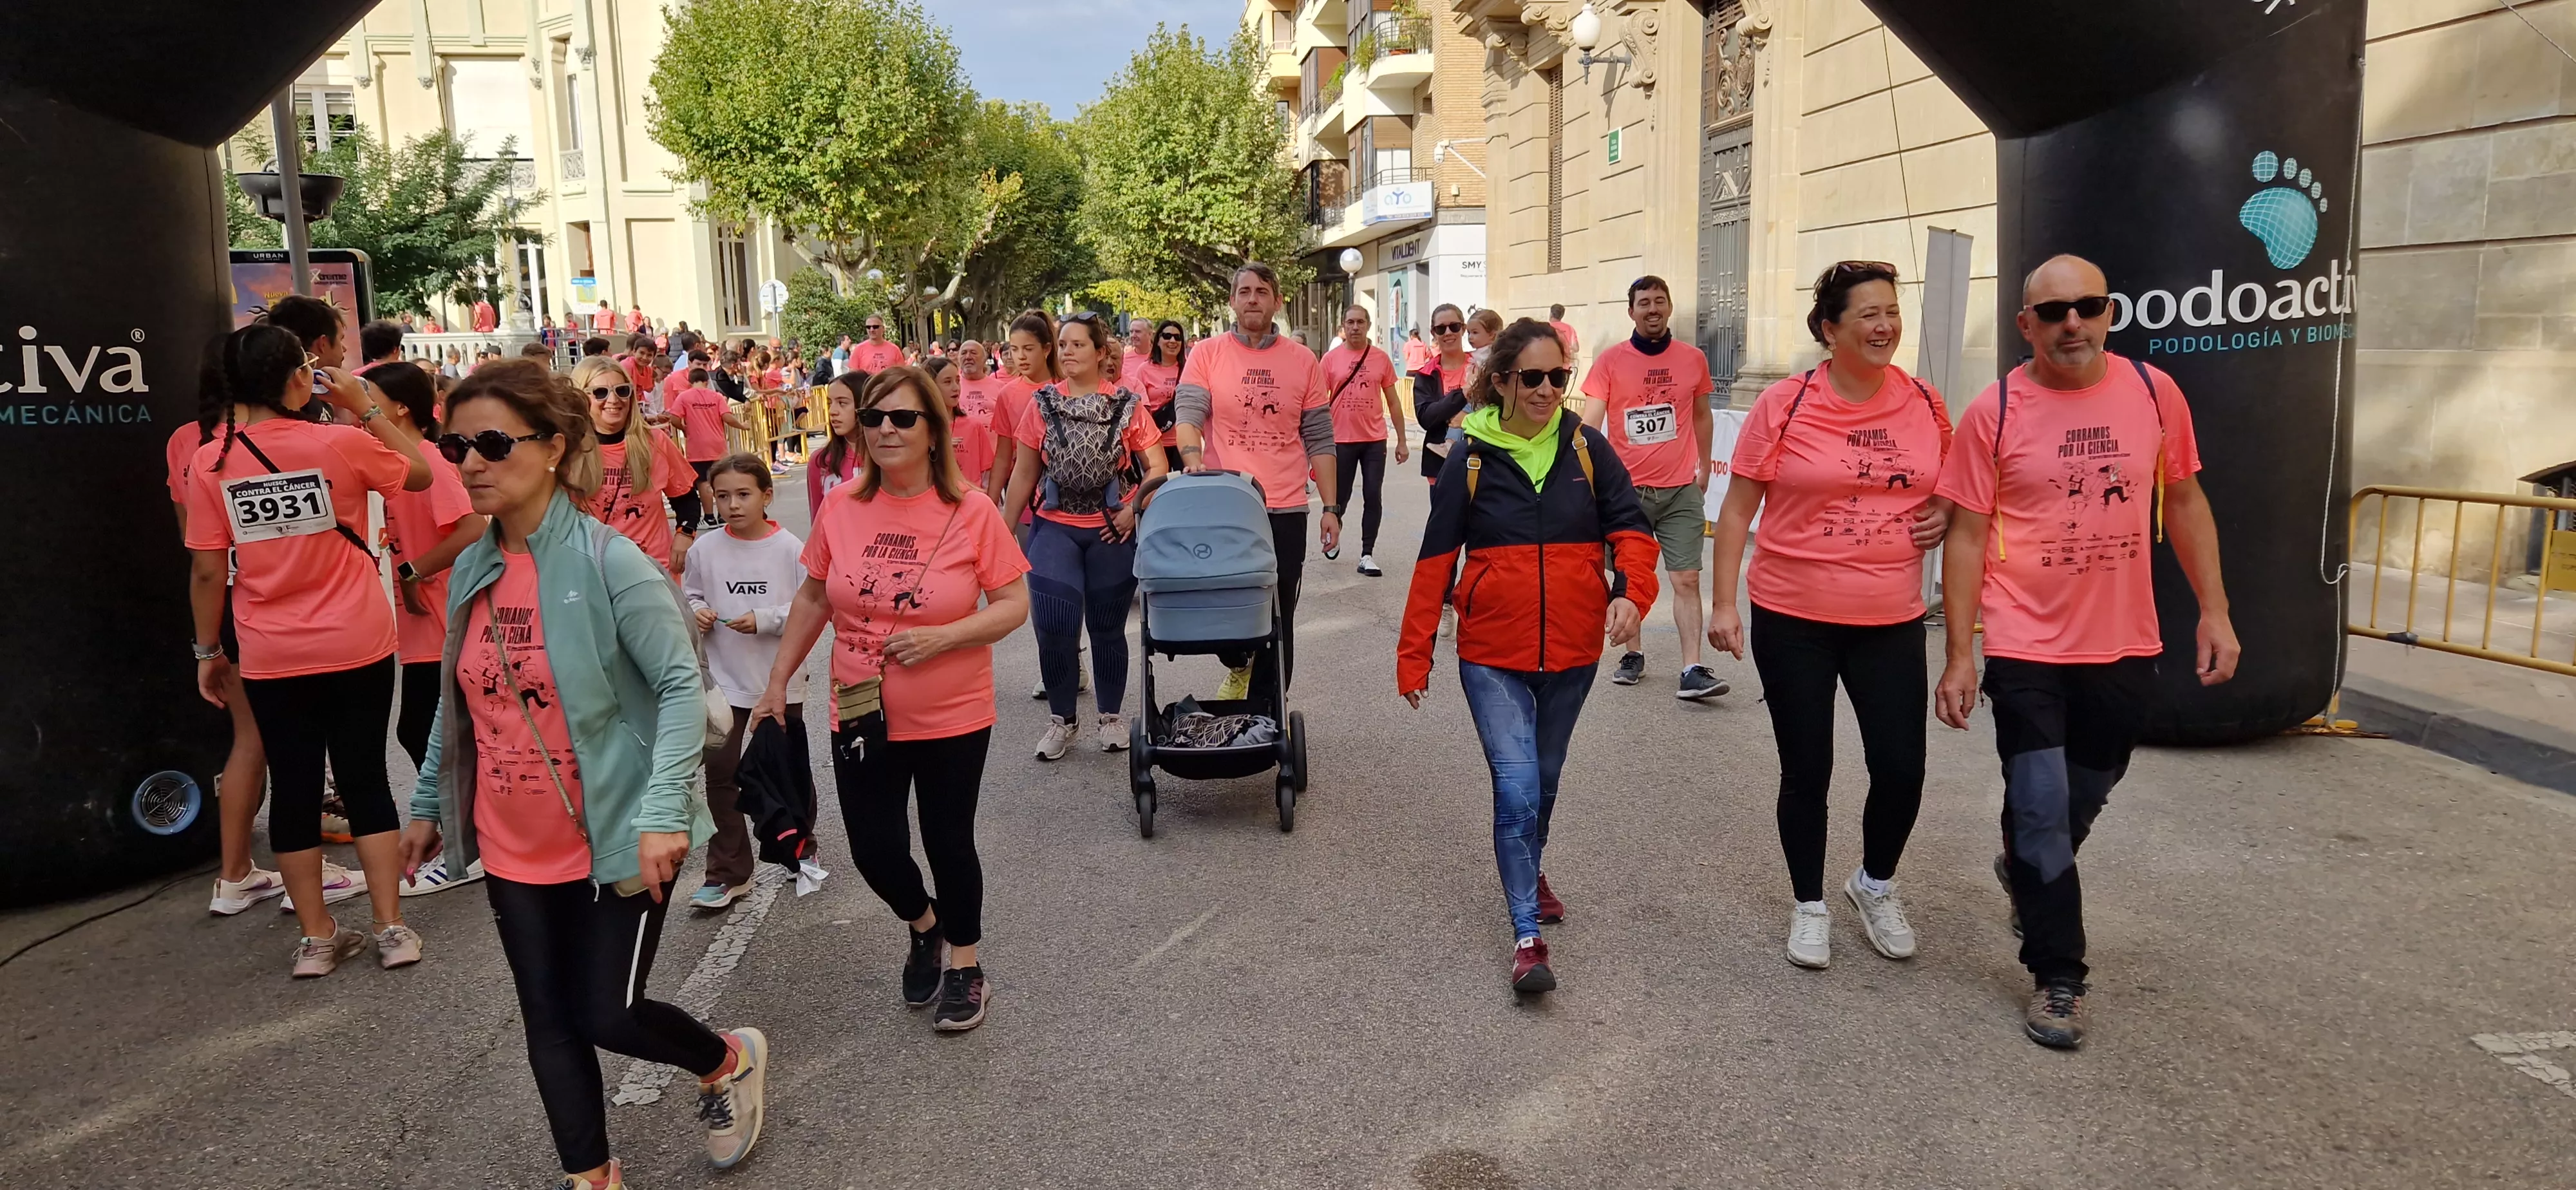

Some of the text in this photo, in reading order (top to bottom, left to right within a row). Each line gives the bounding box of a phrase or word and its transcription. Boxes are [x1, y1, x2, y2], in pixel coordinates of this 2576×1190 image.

[2148, 326, 2283, 355] PODOLOGÍA
[2290, 327, 2301, 344] Y
[1635, 417, 1667, 434] 307
[2066, 426, 2110, 443] CORRAMOS
[2058, 444, 2074, 458] POR
[2076, 442, 2085, 456] LA
[2088, 439, 2119, 455] CIENCIA
[236, 487, 271, 498] CONTRA
[285, 481, 316, 492] CÁNCER
[237, 491, 321, 524] 3931
[873, 533, 916, 549] CORRAMOS
[861, 545, 919, 560] POR LA CIENCIA
[725, 581, 768, 594] VANS
